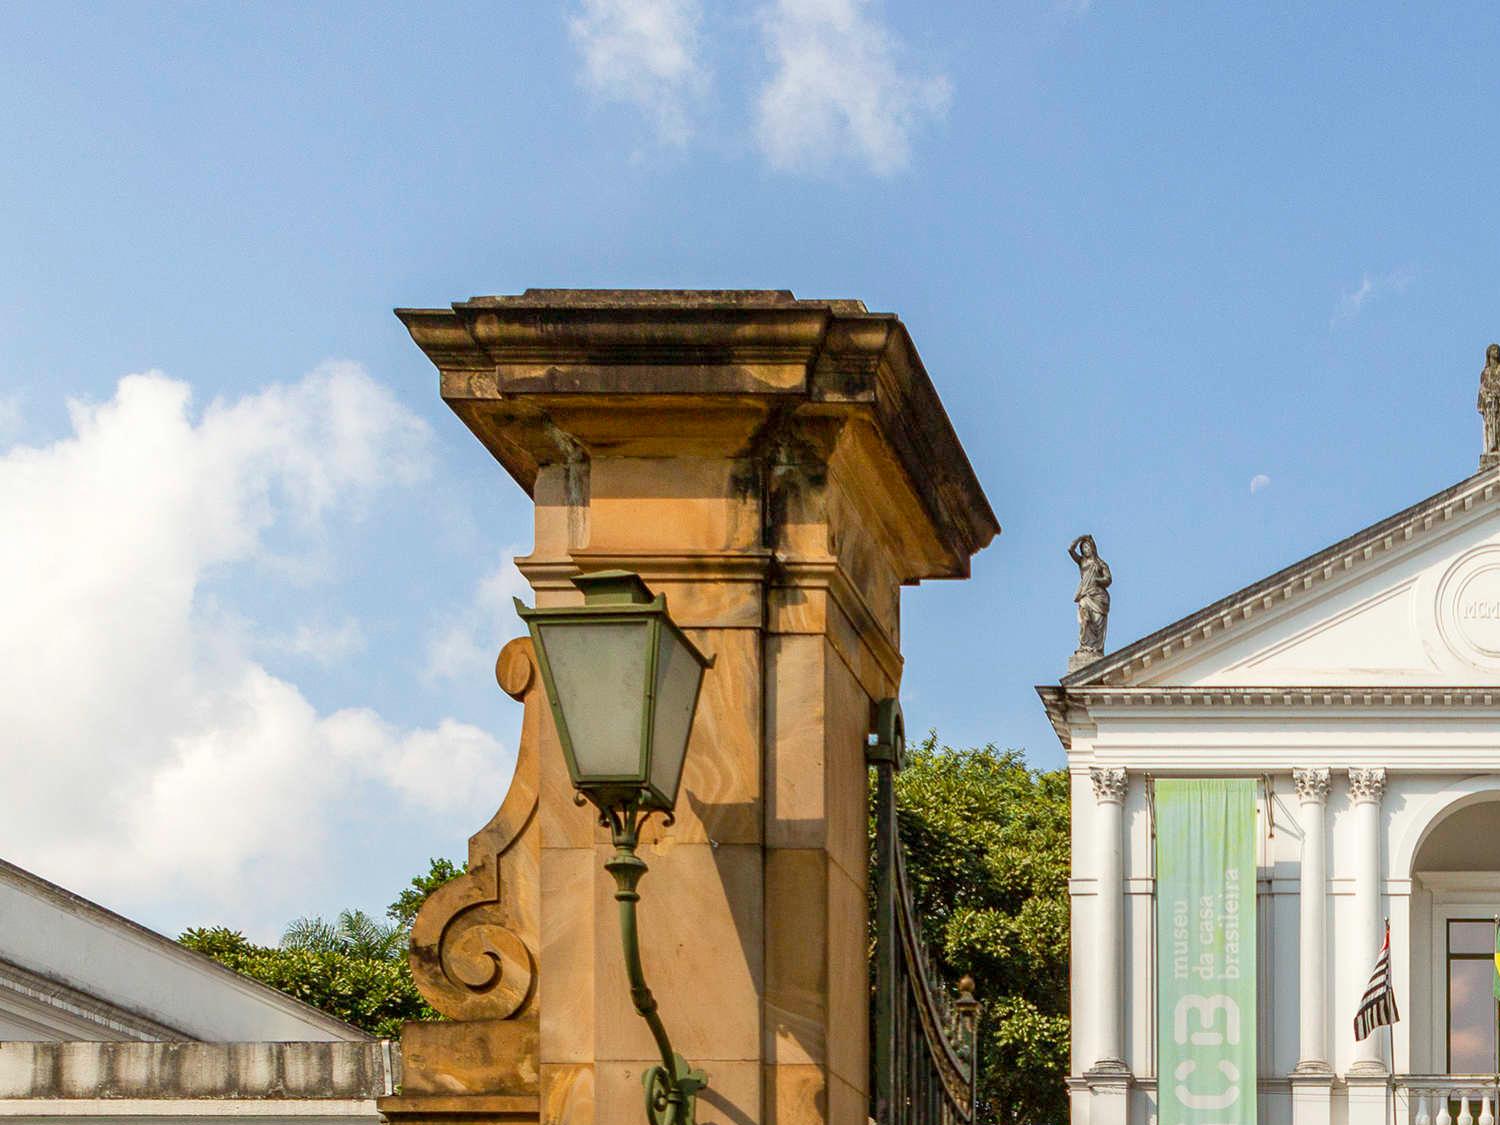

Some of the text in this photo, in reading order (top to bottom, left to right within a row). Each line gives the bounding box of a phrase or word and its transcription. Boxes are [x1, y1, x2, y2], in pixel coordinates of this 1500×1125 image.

[1174, 898, 1188, 978] museu
[1193, 895, 1215, 979] da casa
[1218, 867, 1240, 979] brasileira
